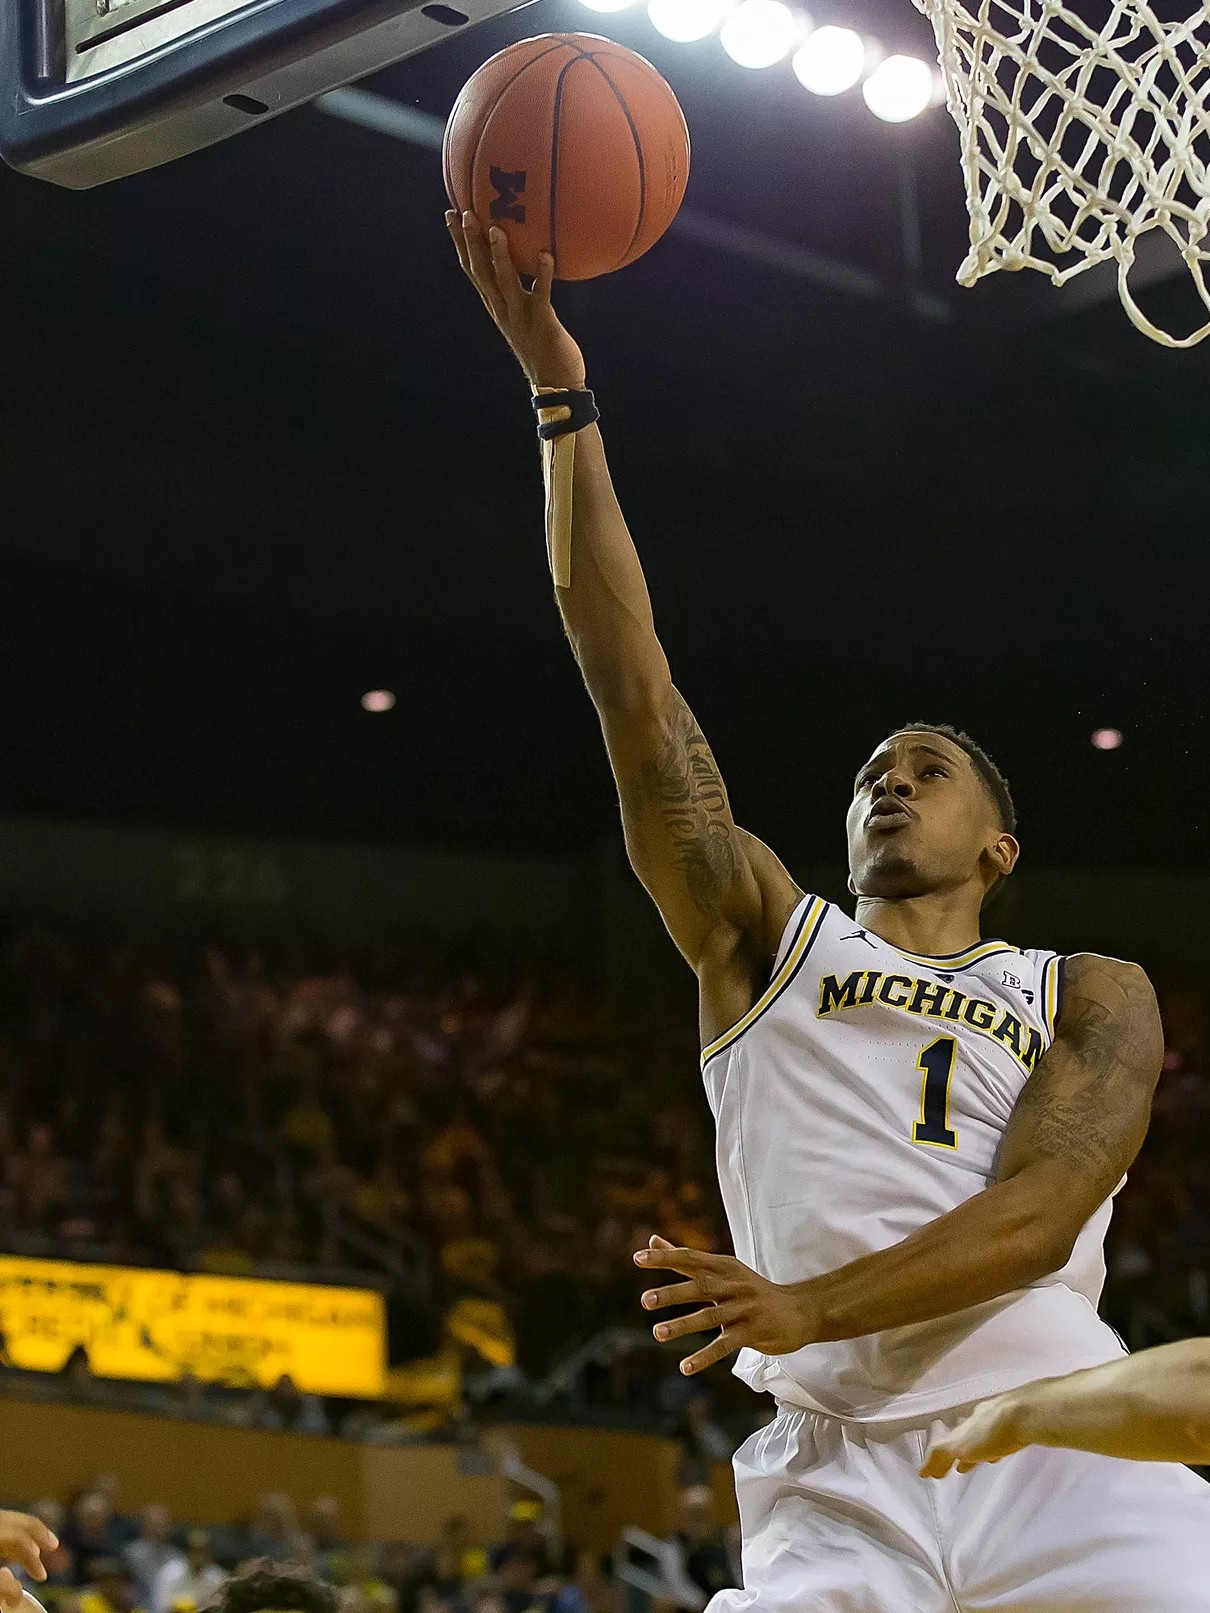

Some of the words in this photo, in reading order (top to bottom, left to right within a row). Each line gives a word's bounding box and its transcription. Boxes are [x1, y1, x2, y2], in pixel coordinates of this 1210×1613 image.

[488, 165, 528, 225] M
[816, 969, 1046, 1072] MICHIGAN
[912, 1034, 958, 1150] 1
